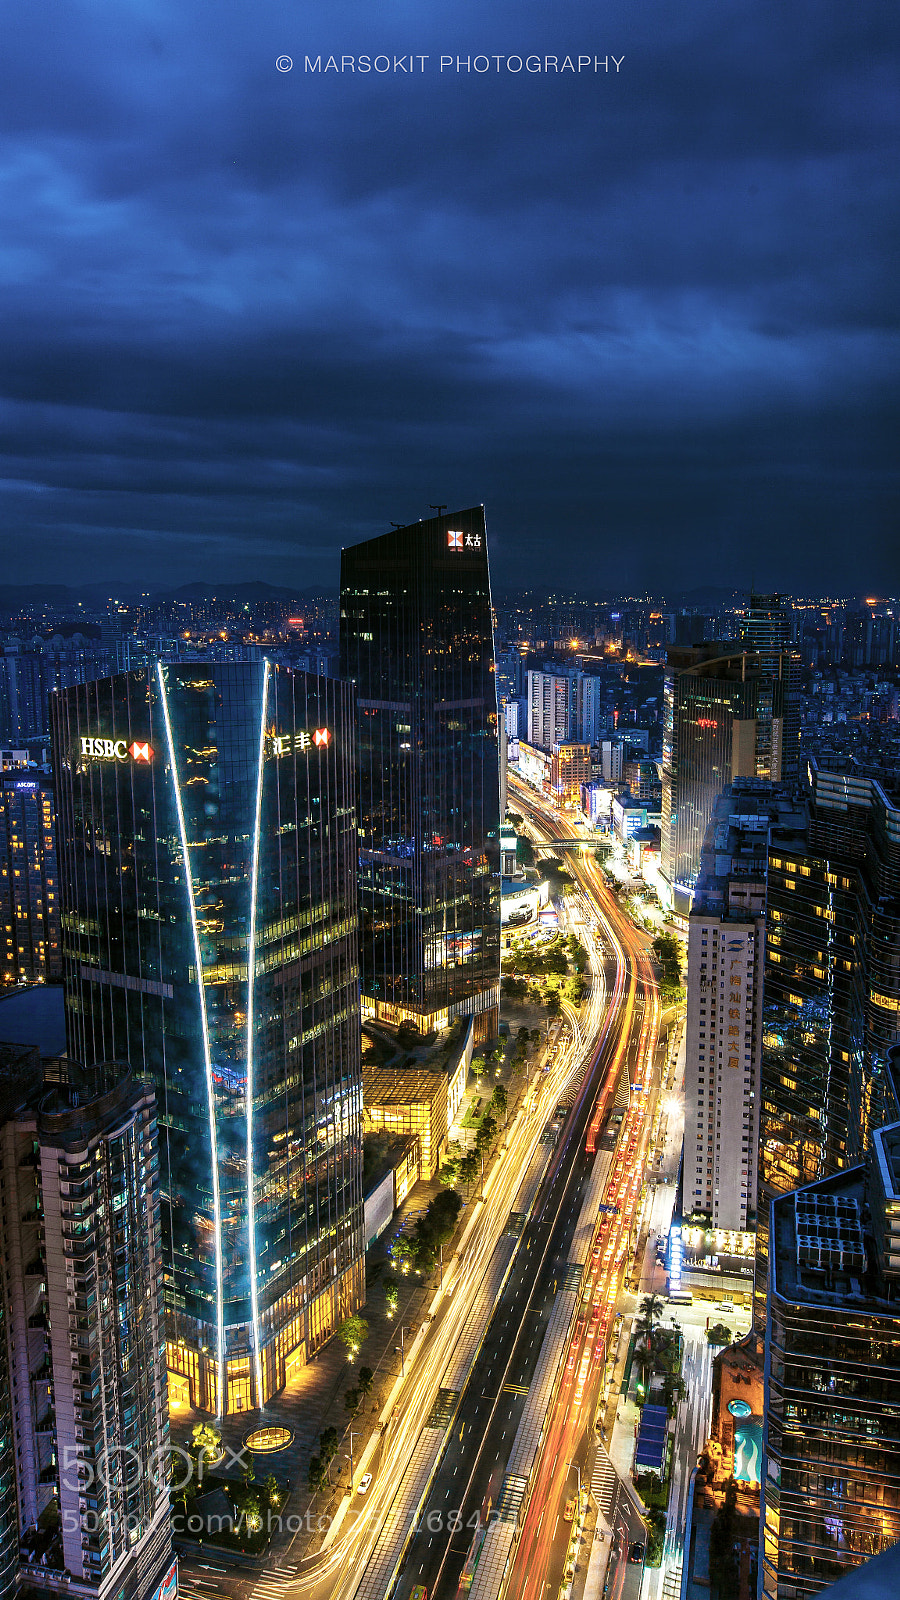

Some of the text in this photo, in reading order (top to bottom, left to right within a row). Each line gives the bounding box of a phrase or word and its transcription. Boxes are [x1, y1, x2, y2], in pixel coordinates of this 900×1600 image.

[464, 533, 482, 547] 太古
[80, 736, 128, 759] HSBC
[272, 731, 311, 755] 汇丰
